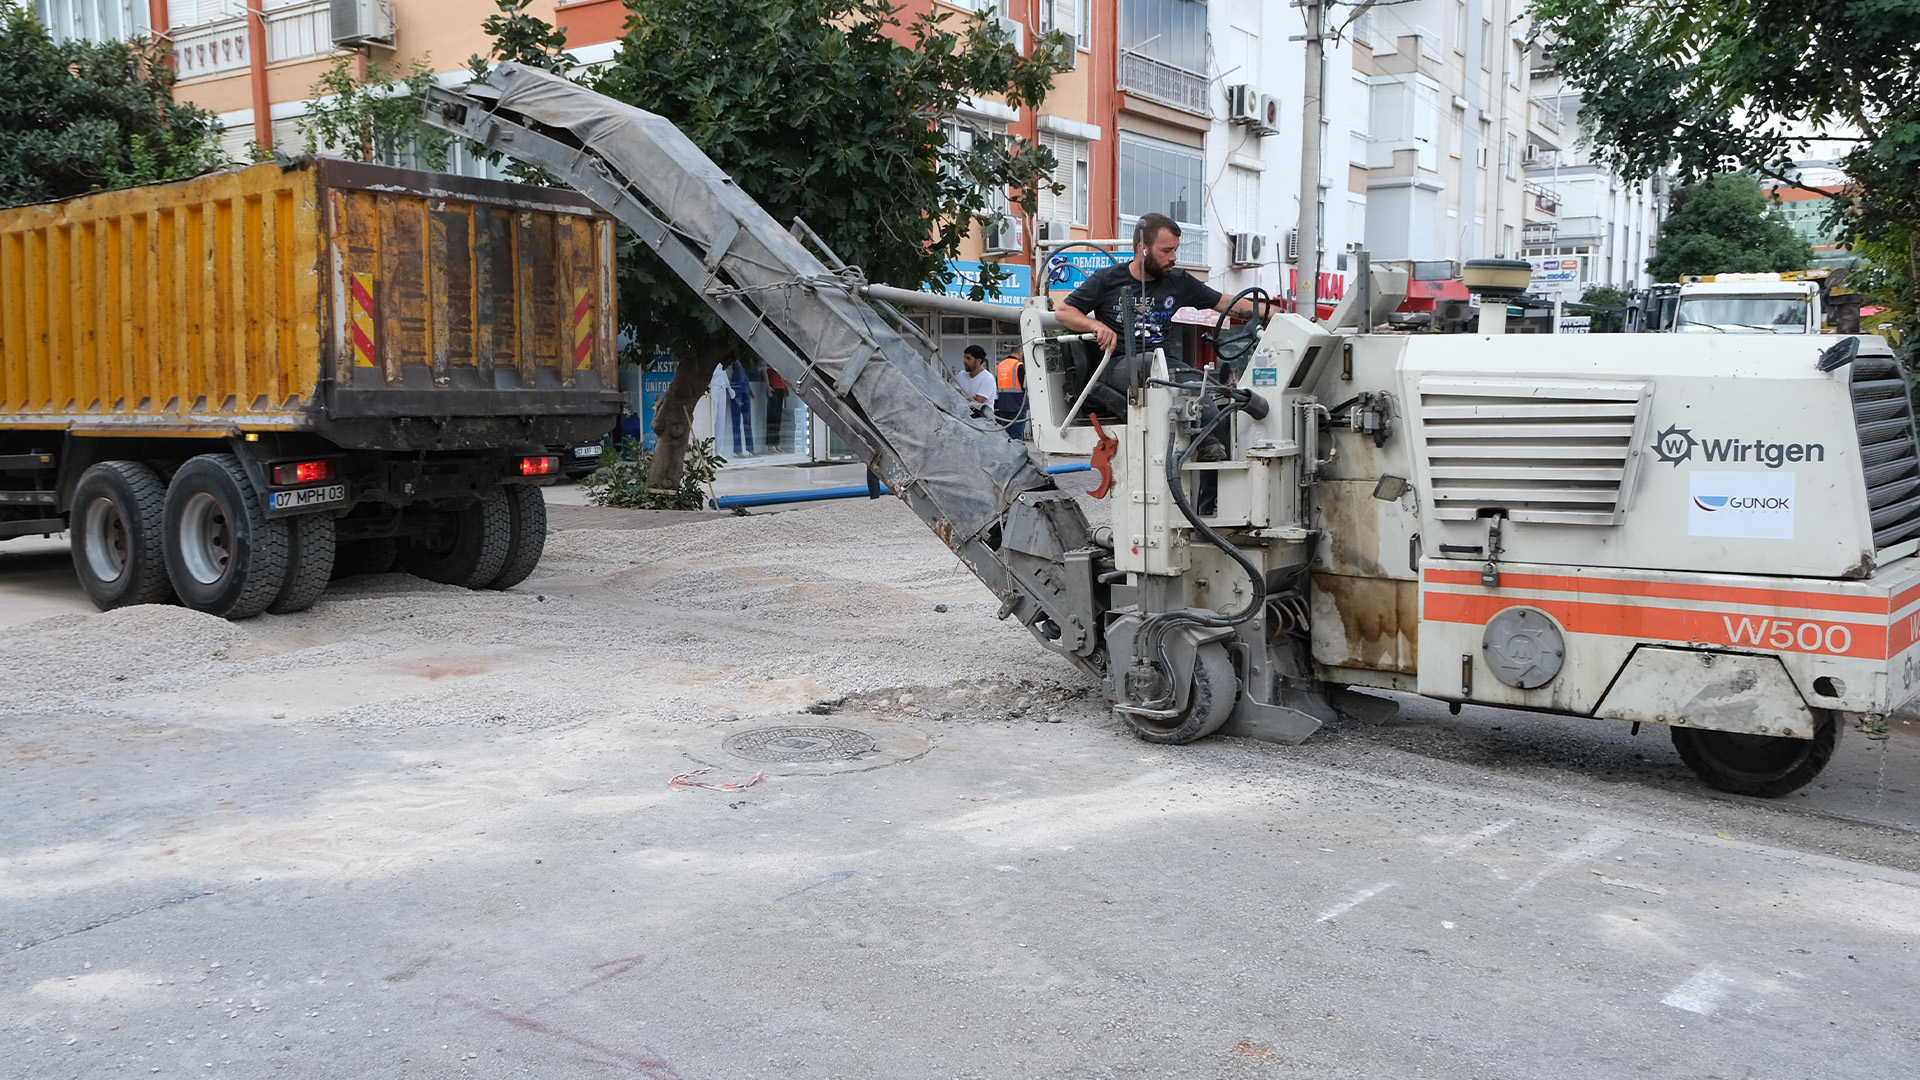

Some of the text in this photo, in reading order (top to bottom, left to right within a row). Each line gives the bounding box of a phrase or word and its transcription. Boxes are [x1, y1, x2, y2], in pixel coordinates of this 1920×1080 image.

[1072, 253, 1111, 269] DEMİREL
[1118, 296, 1155, 307] CLSEA
[1701, 438, 1825, 469] Wirtgen
[276, 486, 344, 507] 07 MPH 03
[1729, 496, 1790, 510] GÜNOK
[1722, 615, 1852, 654] W500
